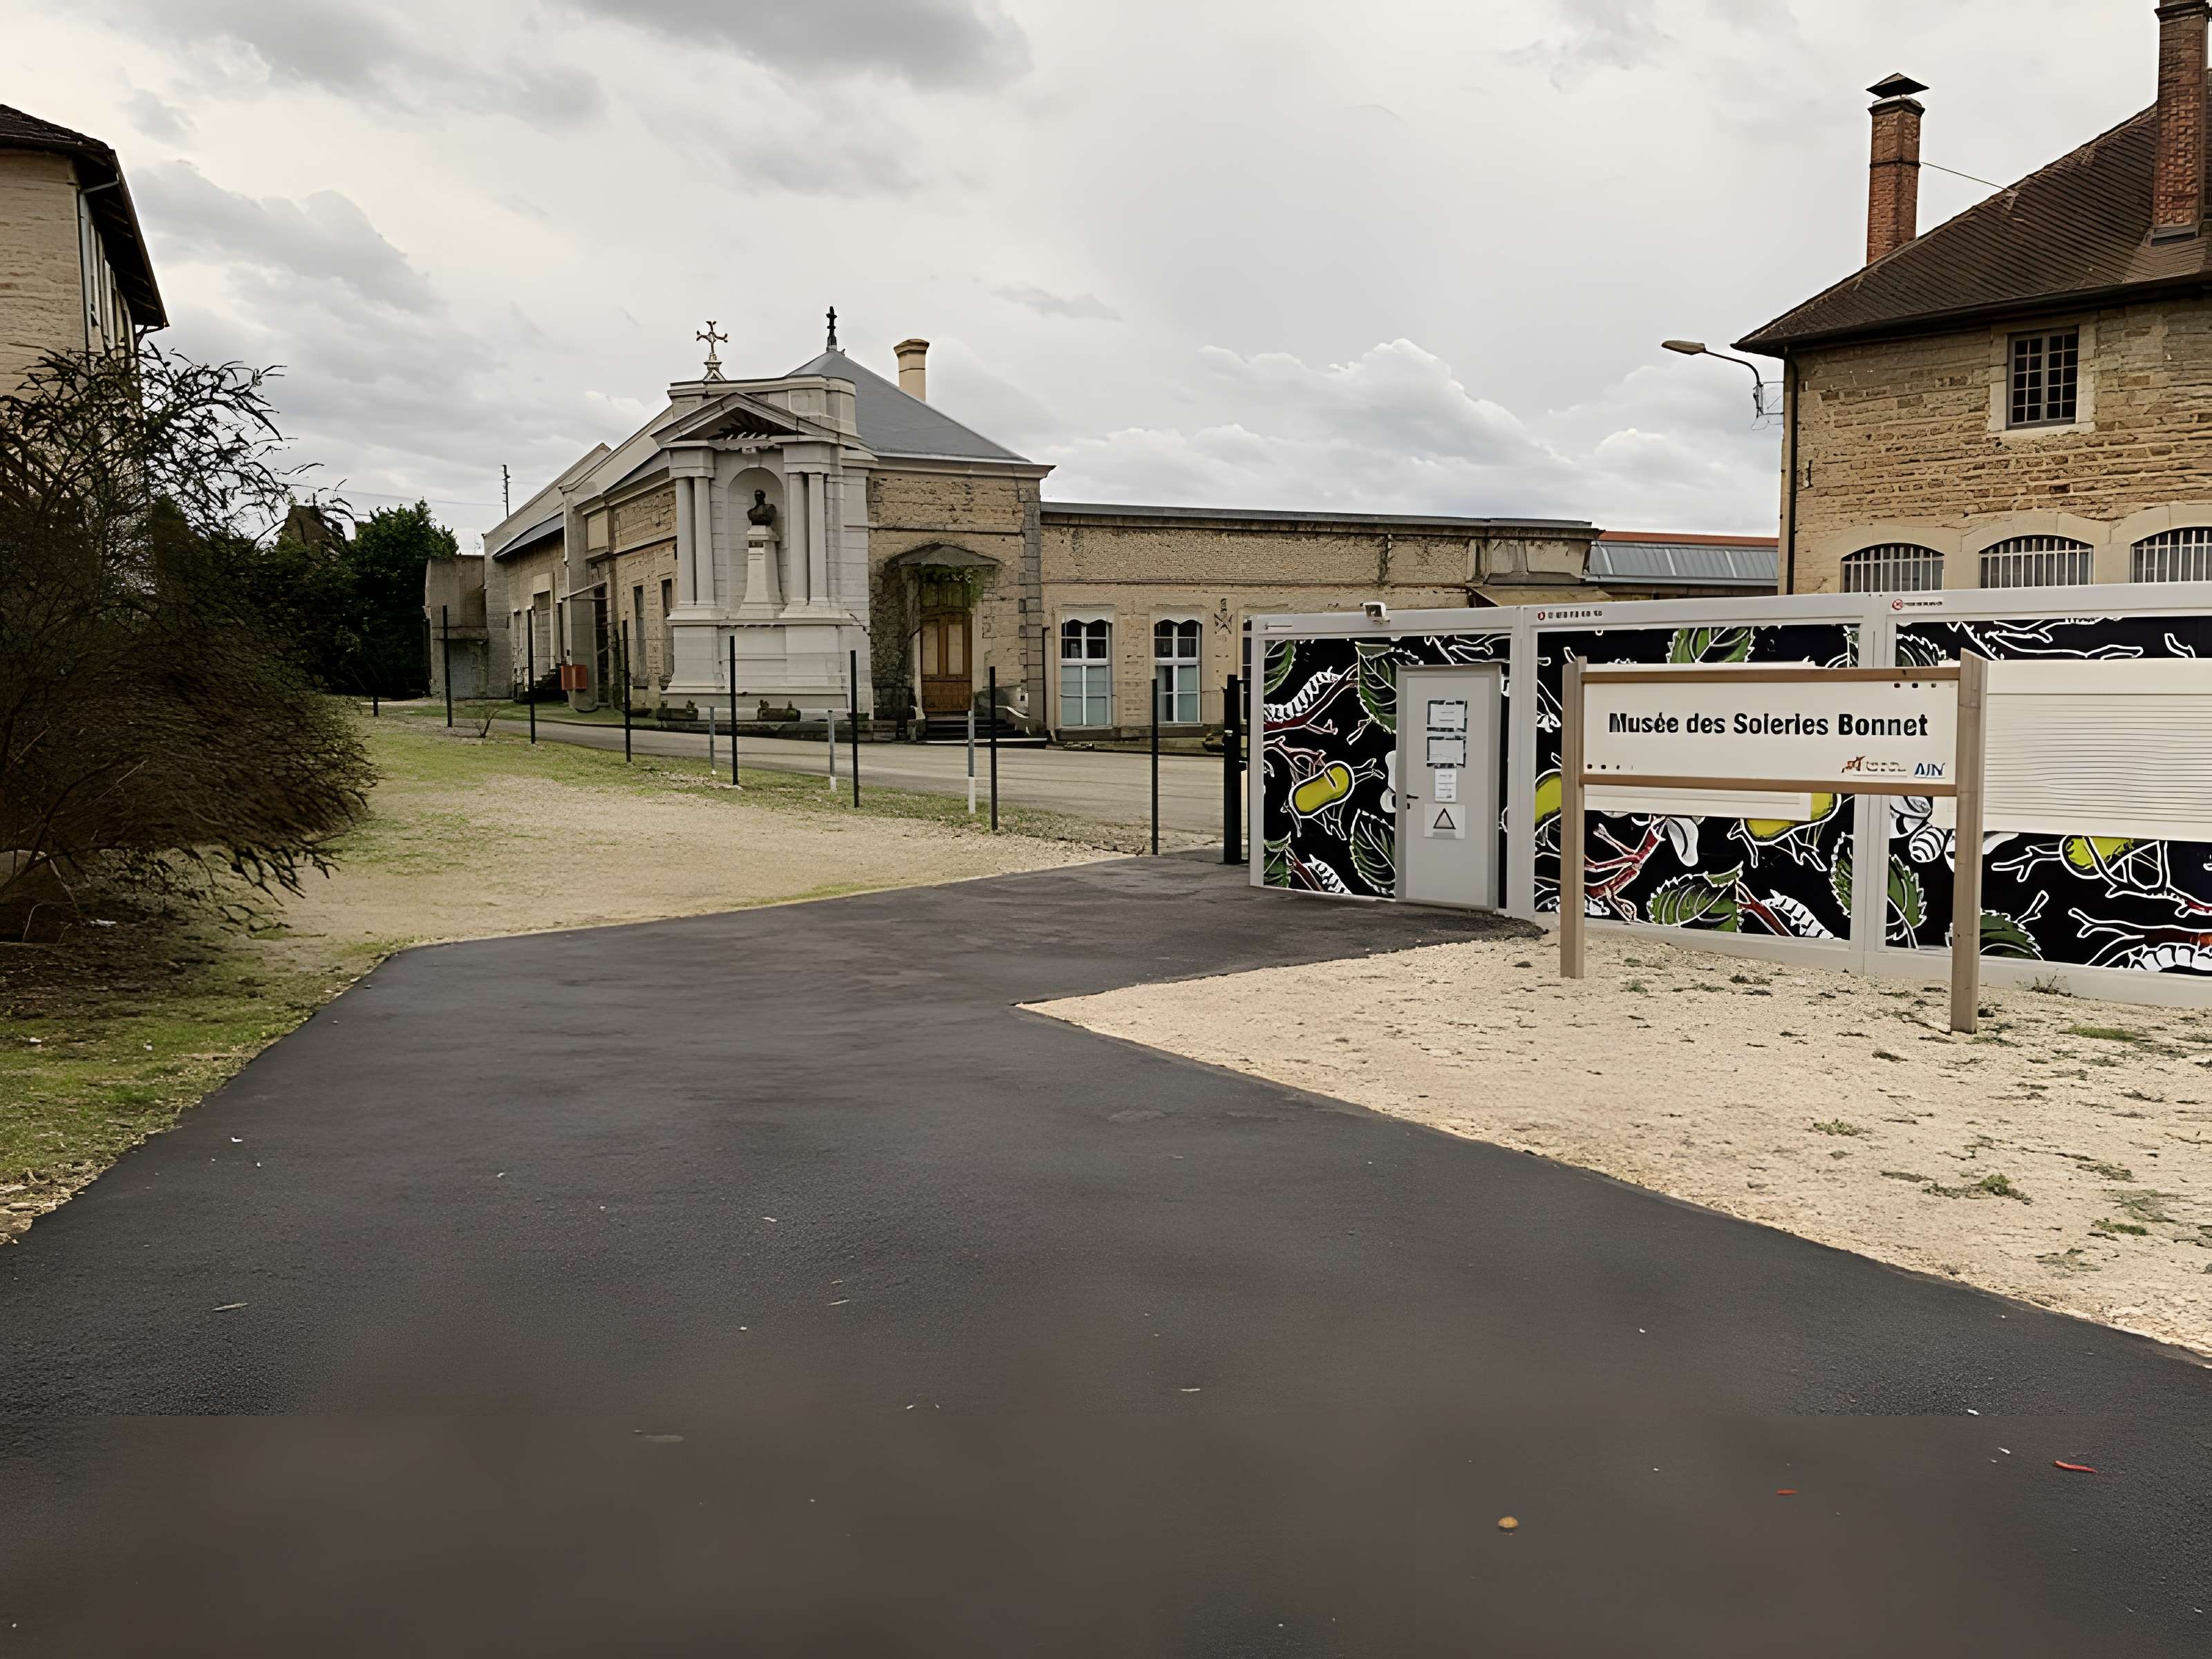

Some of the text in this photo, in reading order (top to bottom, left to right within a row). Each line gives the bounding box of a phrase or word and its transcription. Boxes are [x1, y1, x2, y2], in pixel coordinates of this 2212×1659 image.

[1609, 712, 1678, 733] Musée
[1687, 713, 1725, 733] des
[1838, 713, 1928, 736] Bonnet
